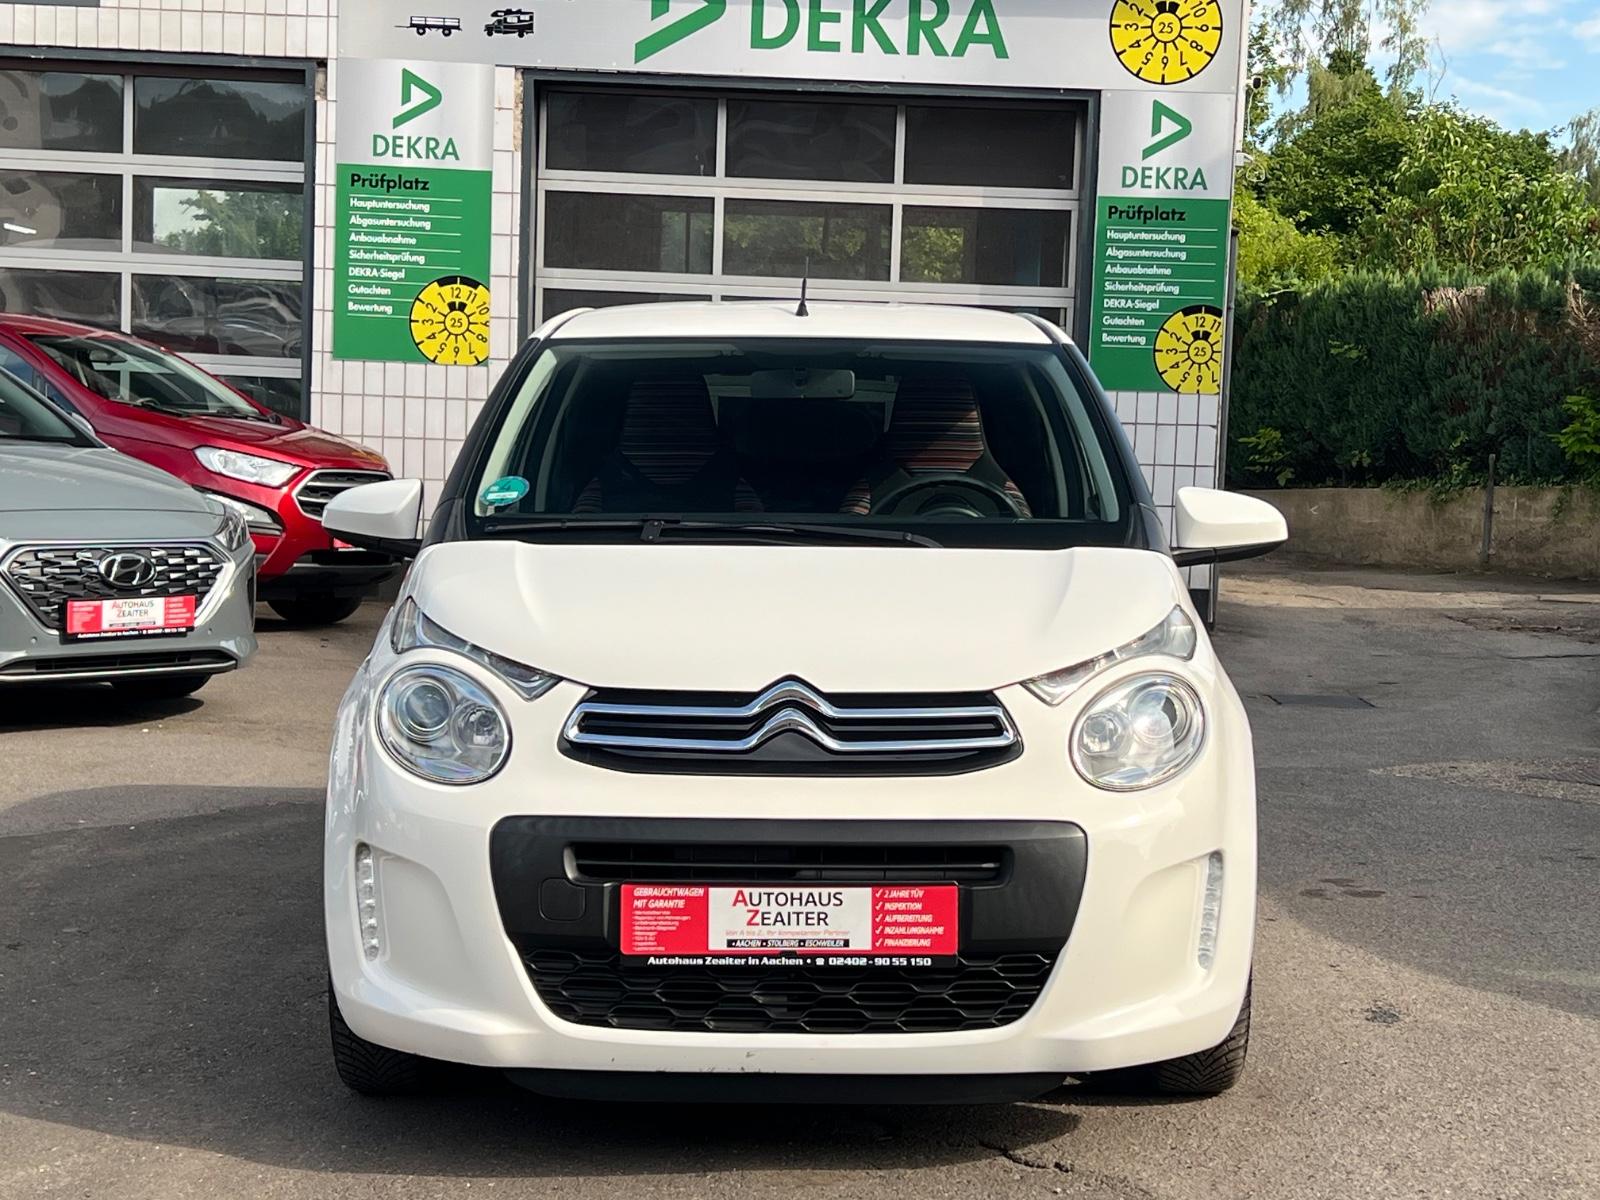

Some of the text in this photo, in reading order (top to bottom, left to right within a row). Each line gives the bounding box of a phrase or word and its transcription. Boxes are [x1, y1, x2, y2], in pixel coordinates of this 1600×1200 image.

[1129, 3, 1144, 16] 2
[750, 0, 1009, 58] DEKRA
[1124, 22, 1139, 31] 3
[1158, 22, 1174, 34] 25
[1194, 24, 1209, 32] 9
[1128, 39, 1141, 48] 4
[1189, 40, 1204, 52] 8
[1141, 51, 1154, 66] 5
[1161, 55, 1169, 71] 6
[1179, 51, 1188, 67] 7
[372, 134, 460, 161] DEKRA
[350, 173, 430, 193] Prüfplatz
[1121, 166, 1208, 191] DEKRA
[349, 198, 431, 213] Hauptuntersuchung
[1108, 205, 1186, 224] Prüfplatz
[349, 214, 432, 231] Abgasuntersuchung
[348, 231, 417, 245] Anbauabnahme
[1106, 229, 1186, 244] Hauptuntersuchung
[348, 249, 426, 265] Sicherheitsprüfung
[1105, 246, 1187, 261] Abgasuntersuchung
[348, 267, 406, 281] DEKRA-Siegel
[1104, 264, 1172, 276] Anbauabnahme
[348, 284, 391, 296] Gutachten
[450, 286, 462, 300] 12
[1104, 281, 1180, 295] Sicherheitsprüfung
[466, 290, 478, 305] 11
[347, 301, 393, 315] Bewertung
[425, 302, 438, 314] 2
[476, 301, 490, 316] 10
[1103, 298, 1160, 312] DEKRA-Siegel
[422, 318, 434, 327] 3
[450, 318, 463, 329] 25
[1102, 315, 1145, 327] Gutachten
[1195, 316, 1206, 328] 12
[1210, 319, 1221, 333] 11
[426, 332, 437, 340] 4
[476, 333, 488, 344] 8
[1101, 332, 1146, 346] Bewertung
[1169, 331, 1182, 343] 2
[437, 342, 447, 354] 5
[453, 346, 460, 358] 6
[1193, 347, 1207, 357] 25
[1169, 361, 1180, 369] 4
[1180, 371, 1191, 383] 5
[1196, 374, 1203, 387] 6
[112, 600, 154, 608] AUTOHAUS
[633, 887, 705, 897] GEBRAUCHTWAGEN
[732, 890, 843, 907] AUTOHAUS
[633, 899, 686, 909] MIT GARANTIE
[884, 902, 922, 910] INSPEKTION
[746, 909, 829, 926] ZEAITER
[884, 938, 931, 947] FINANZIERUNG
[647, 956, 703, 965] Autohaus
[705, 956, 746, 965] Zeaiter
[747, 956, 759, 965] in
[761, 956, 803, 965] Aachen
[910, 957, 932, 966] 150
